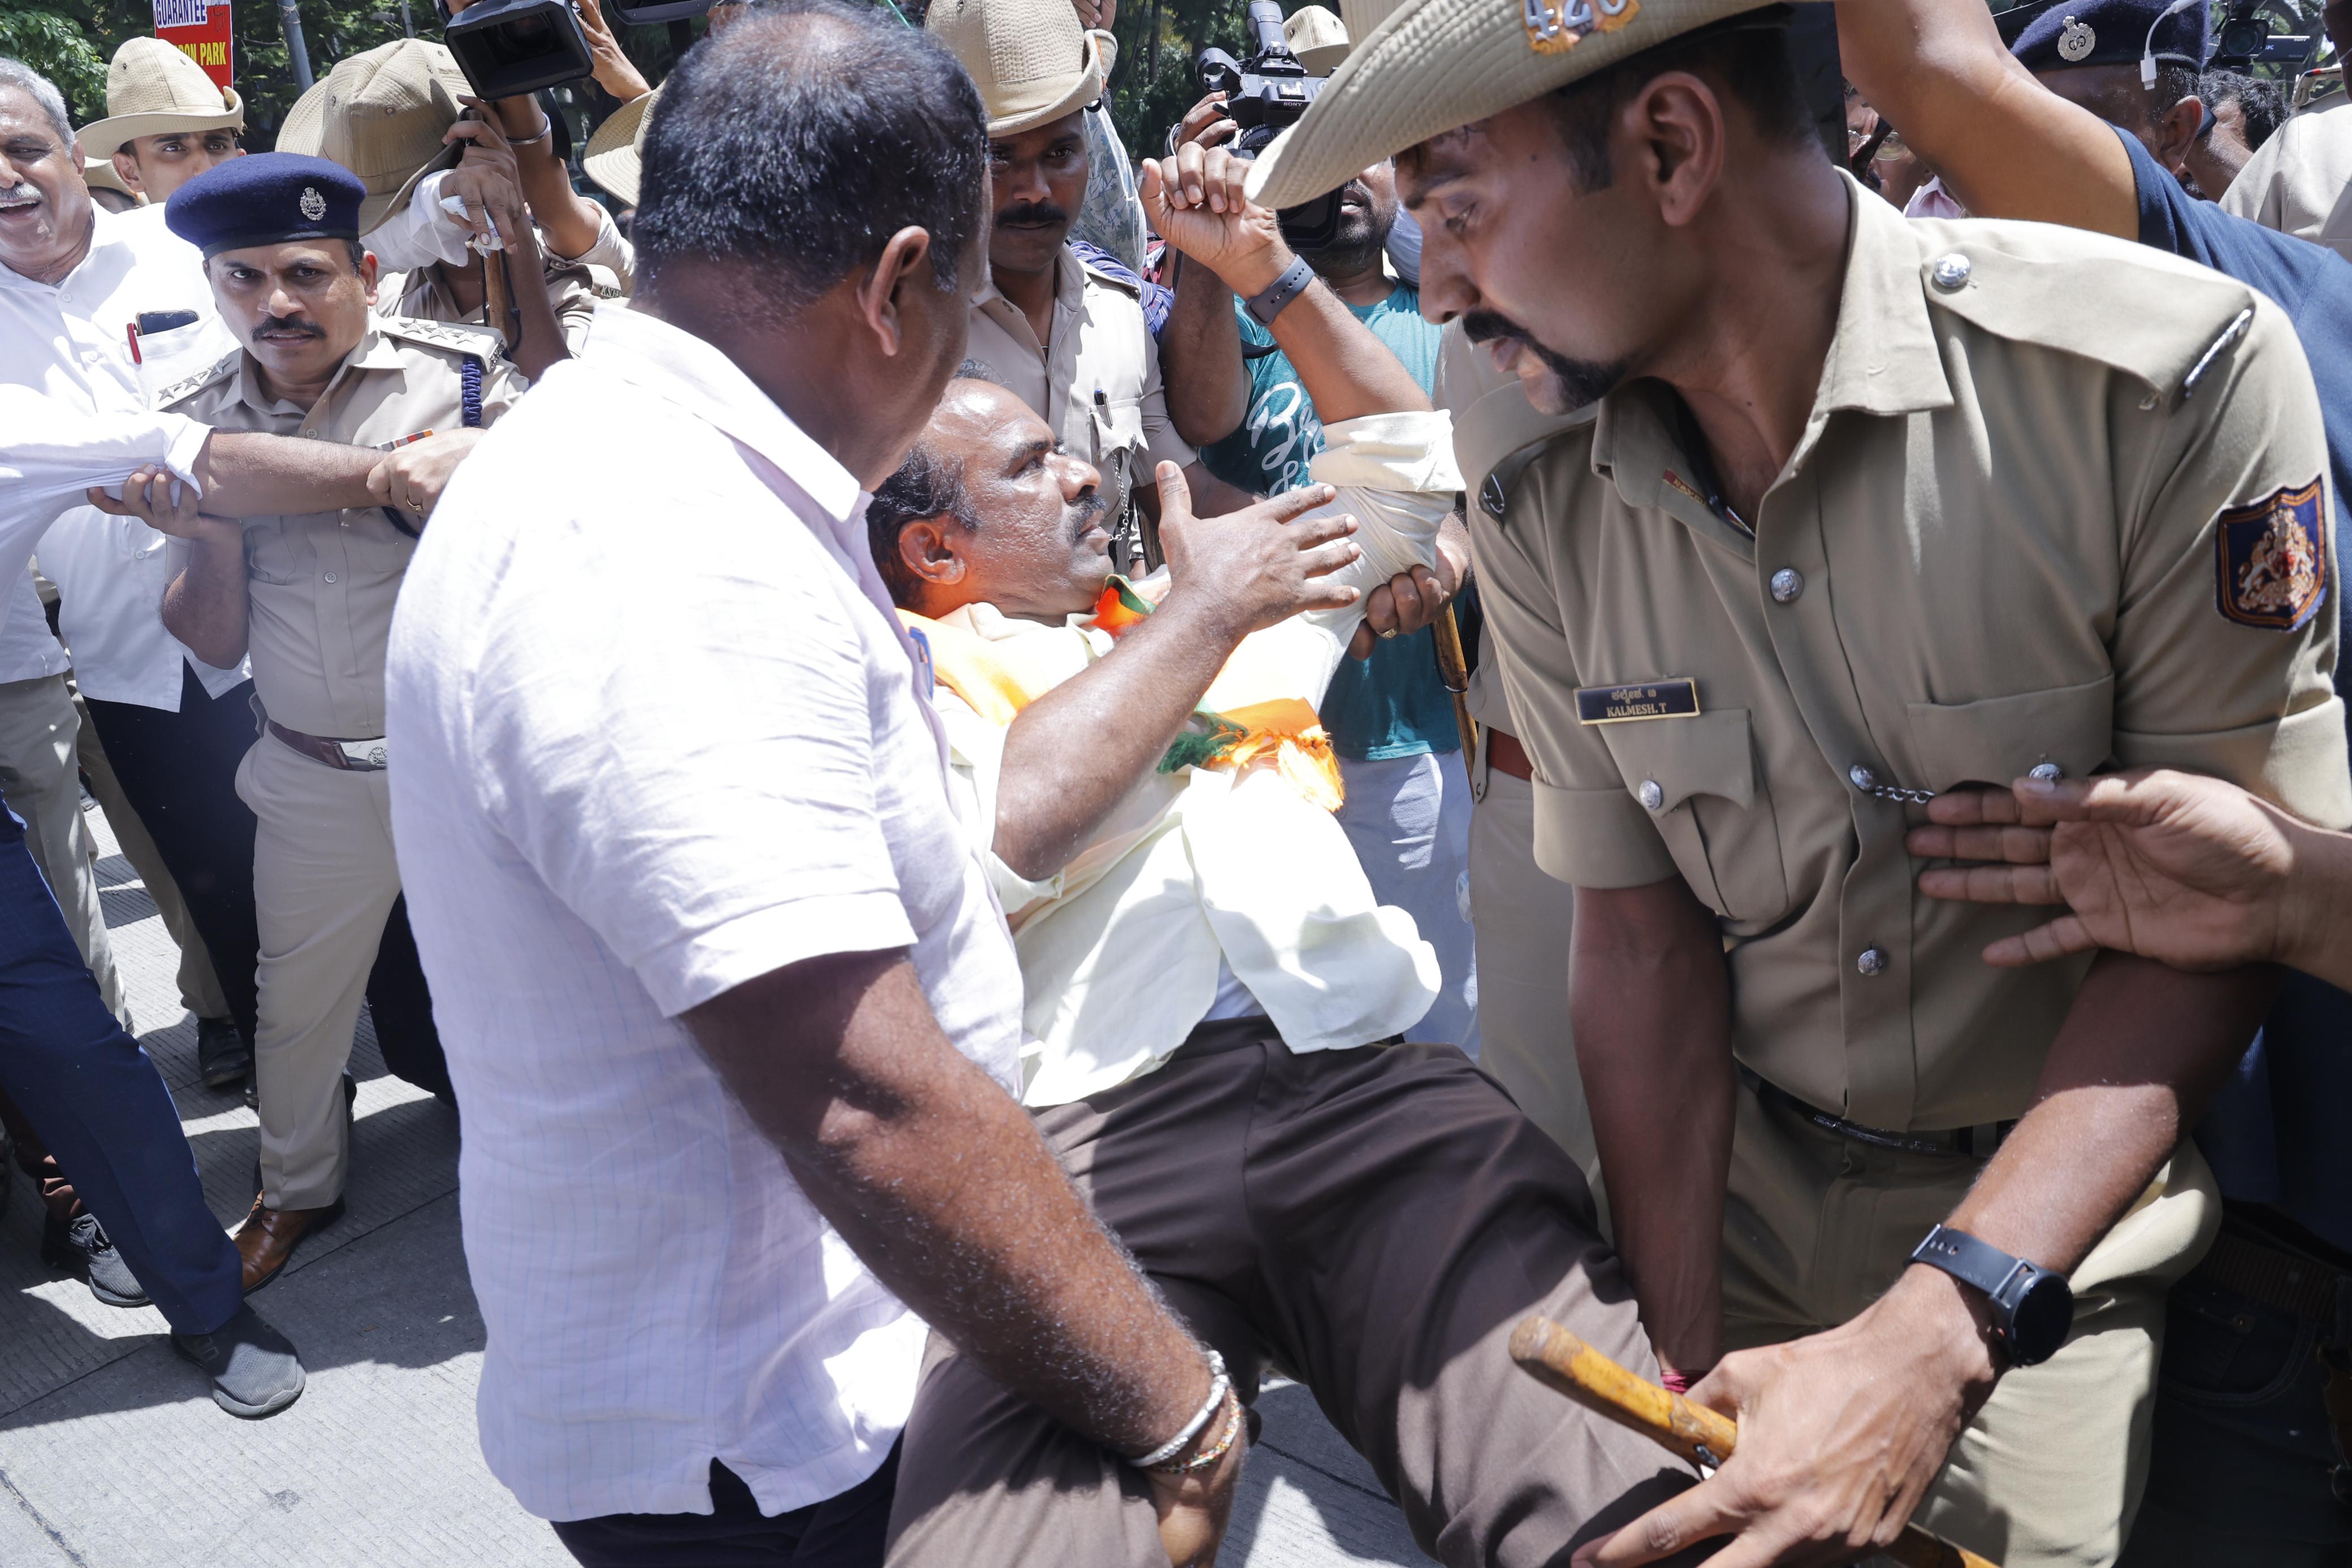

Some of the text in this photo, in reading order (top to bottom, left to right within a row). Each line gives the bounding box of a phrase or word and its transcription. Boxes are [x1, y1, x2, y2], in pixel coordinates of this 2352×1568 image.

[156, 0, 206, 26] GUARANTEE
[200, 42, 227, 66] PARK
[1606, 702, 1667, 717] KALMESH. T
